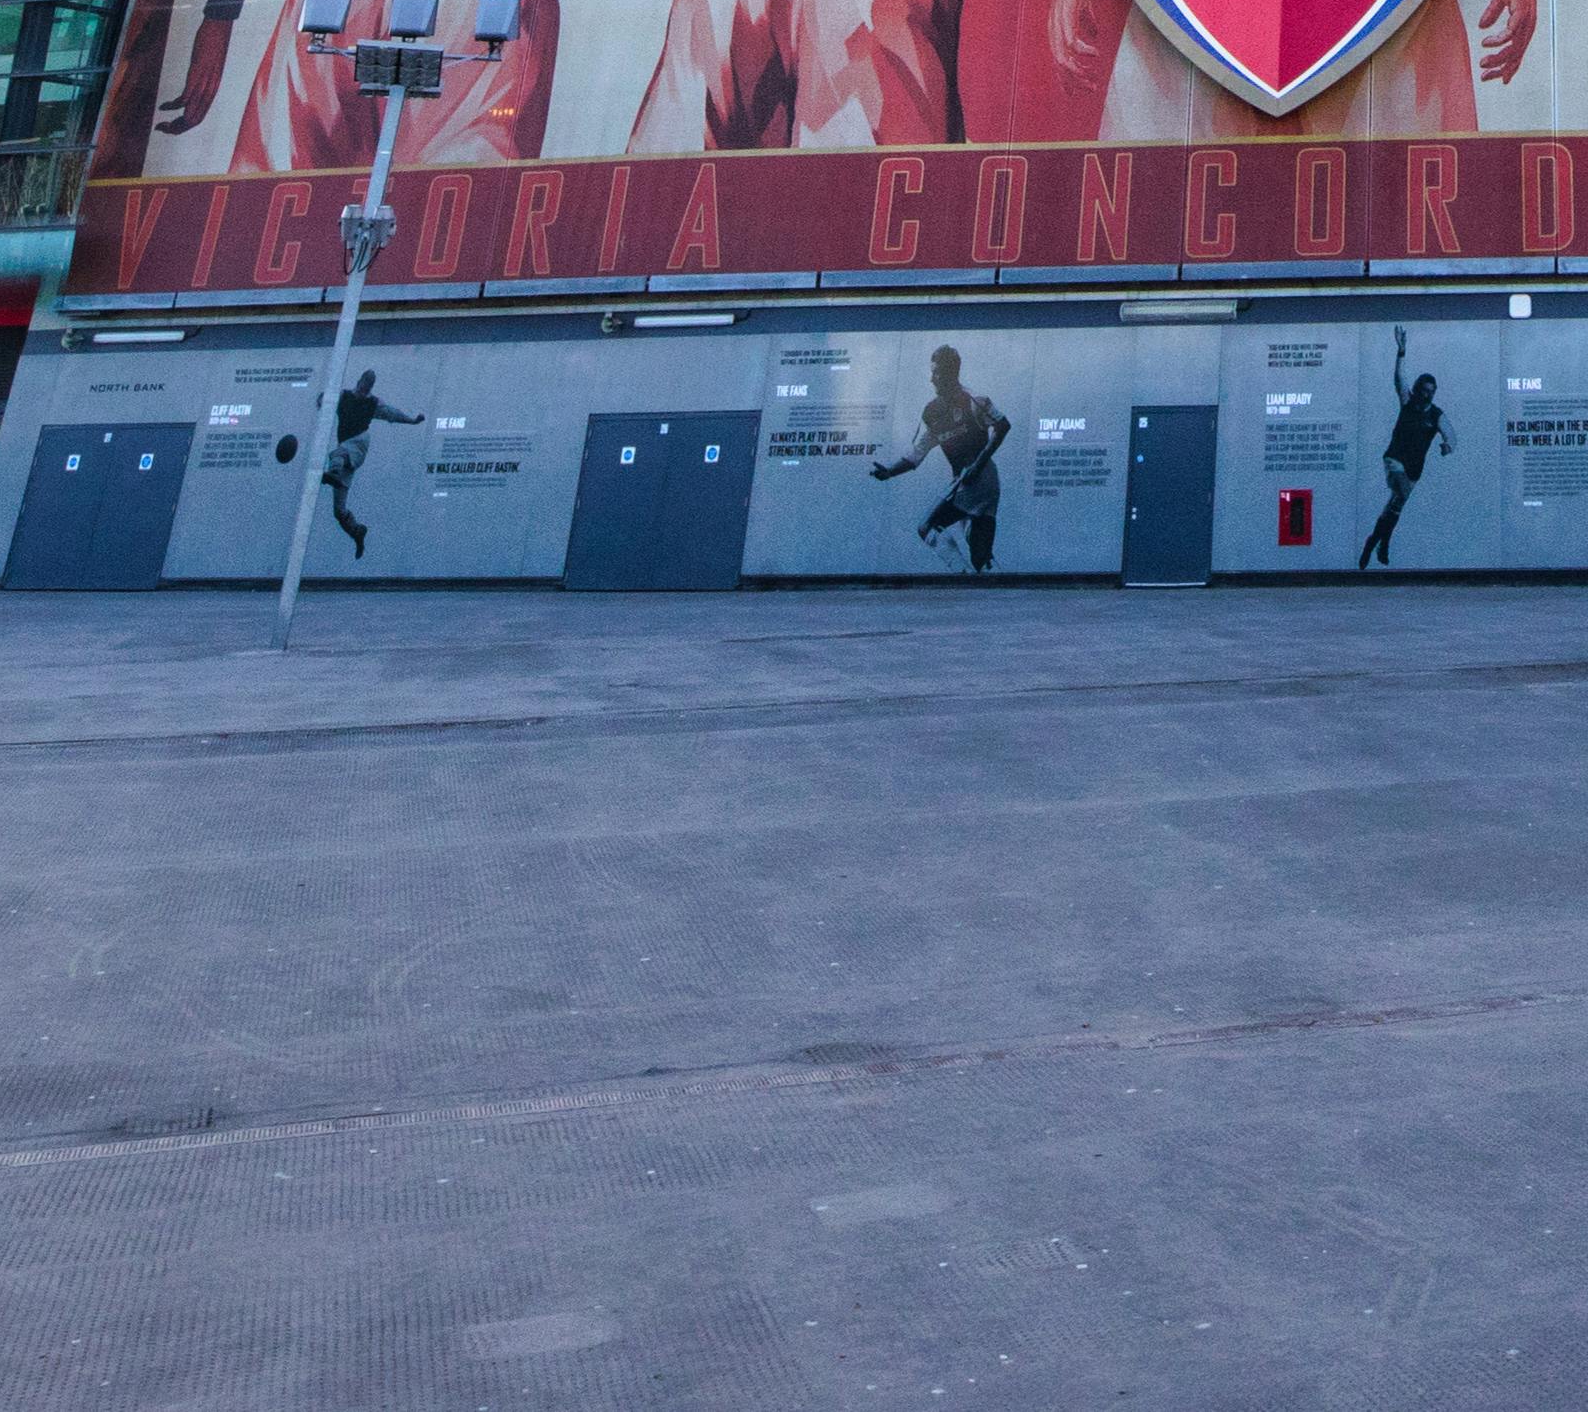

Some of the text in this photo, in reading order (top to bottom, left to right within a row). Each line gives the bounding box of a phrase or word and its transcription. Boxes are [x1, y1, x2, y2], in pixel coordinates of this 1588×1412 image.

[89, 382, 165, 393] NORTH BANK
[1507, 377, 1542, 390] THE FANS
[776, 385, 808, 397] THE FANS
[1266, 392, 1313, 405] LIAM BRADY
[436, 417, 466, 429] THE FANS
[1039, 417, 1086, 430] TONY ADAMS
[1567, 420, 1580, 432] THE
